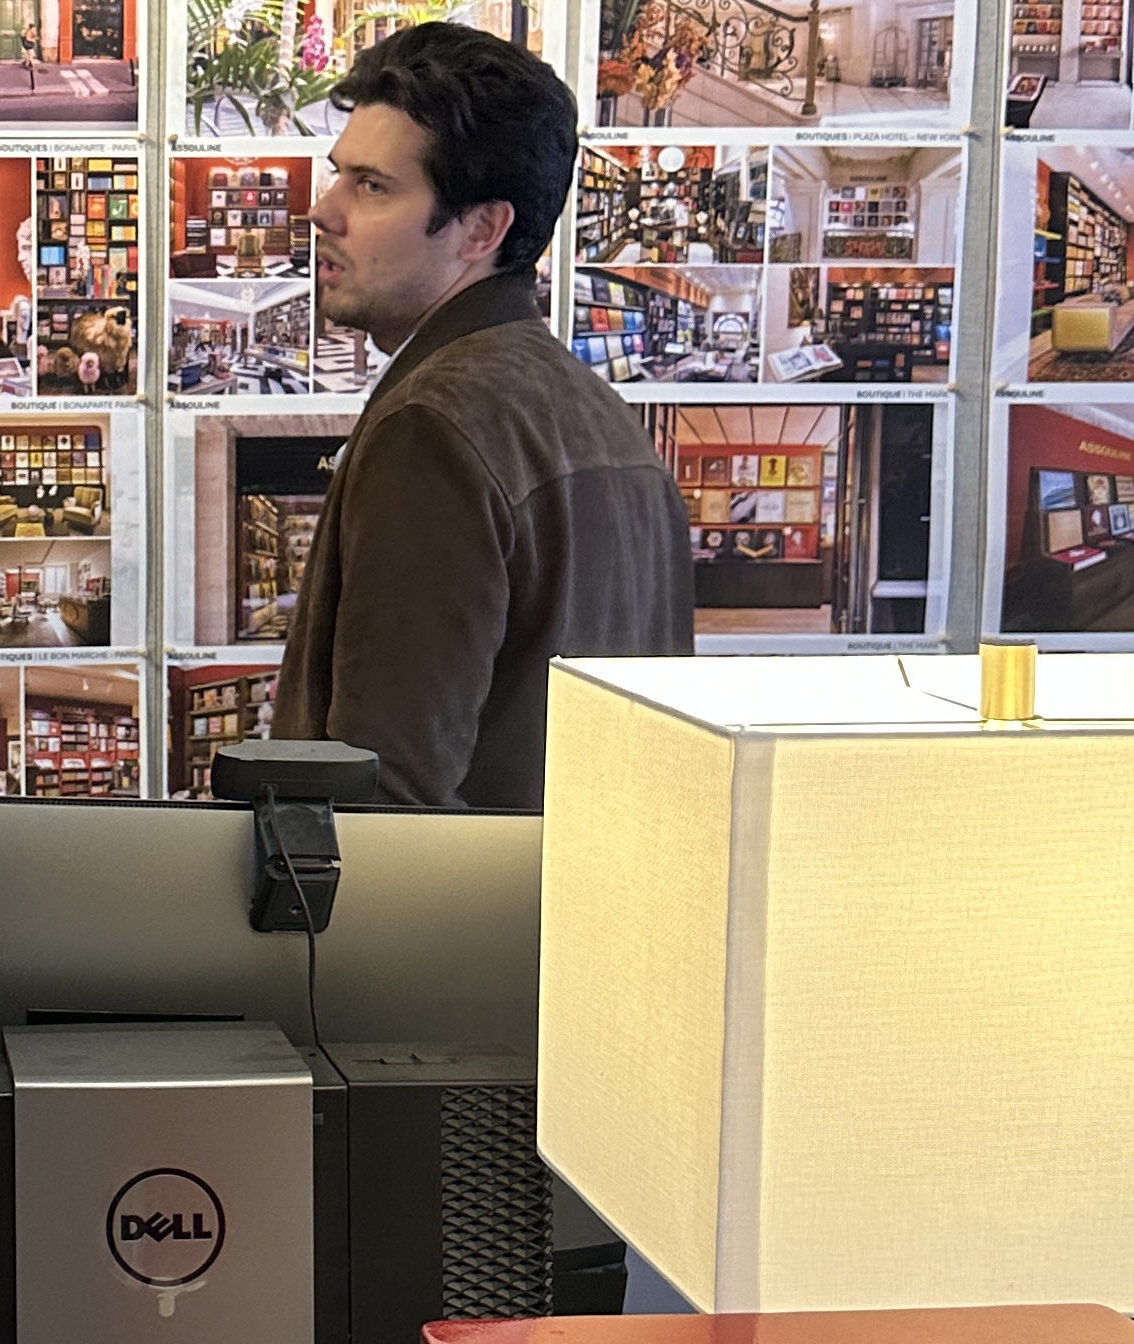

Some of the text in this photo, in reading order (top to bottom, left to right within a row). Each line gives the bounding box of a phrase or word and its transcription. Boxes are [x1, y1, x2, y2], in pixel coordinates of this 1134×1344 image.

[795, 131, 848, 143] BOUTIQUES
[853, 132, 880, 142] PLAZA
[916, 132, 938, 142] NEW
[938, 133, 962, 143] YORK
[53, 143, 105, 153] BONAPARTE
[111, 143, 138, 153] PARIS
[856, 389, 902, 400] BOUTIQUE
[907, 390, 923, 399] THE
[10, 401, 57, 412] BOUTIQUE
[63, 401, 113, 410] BONAPARTE
[847, 641, 892, 652] BOUTIQUE
[898, 641, 914, 651] THE
[38, 652, 49, 661] LE
[50, 651, 70, 660] BON
[120, 1211, 213, 1243] DELL
